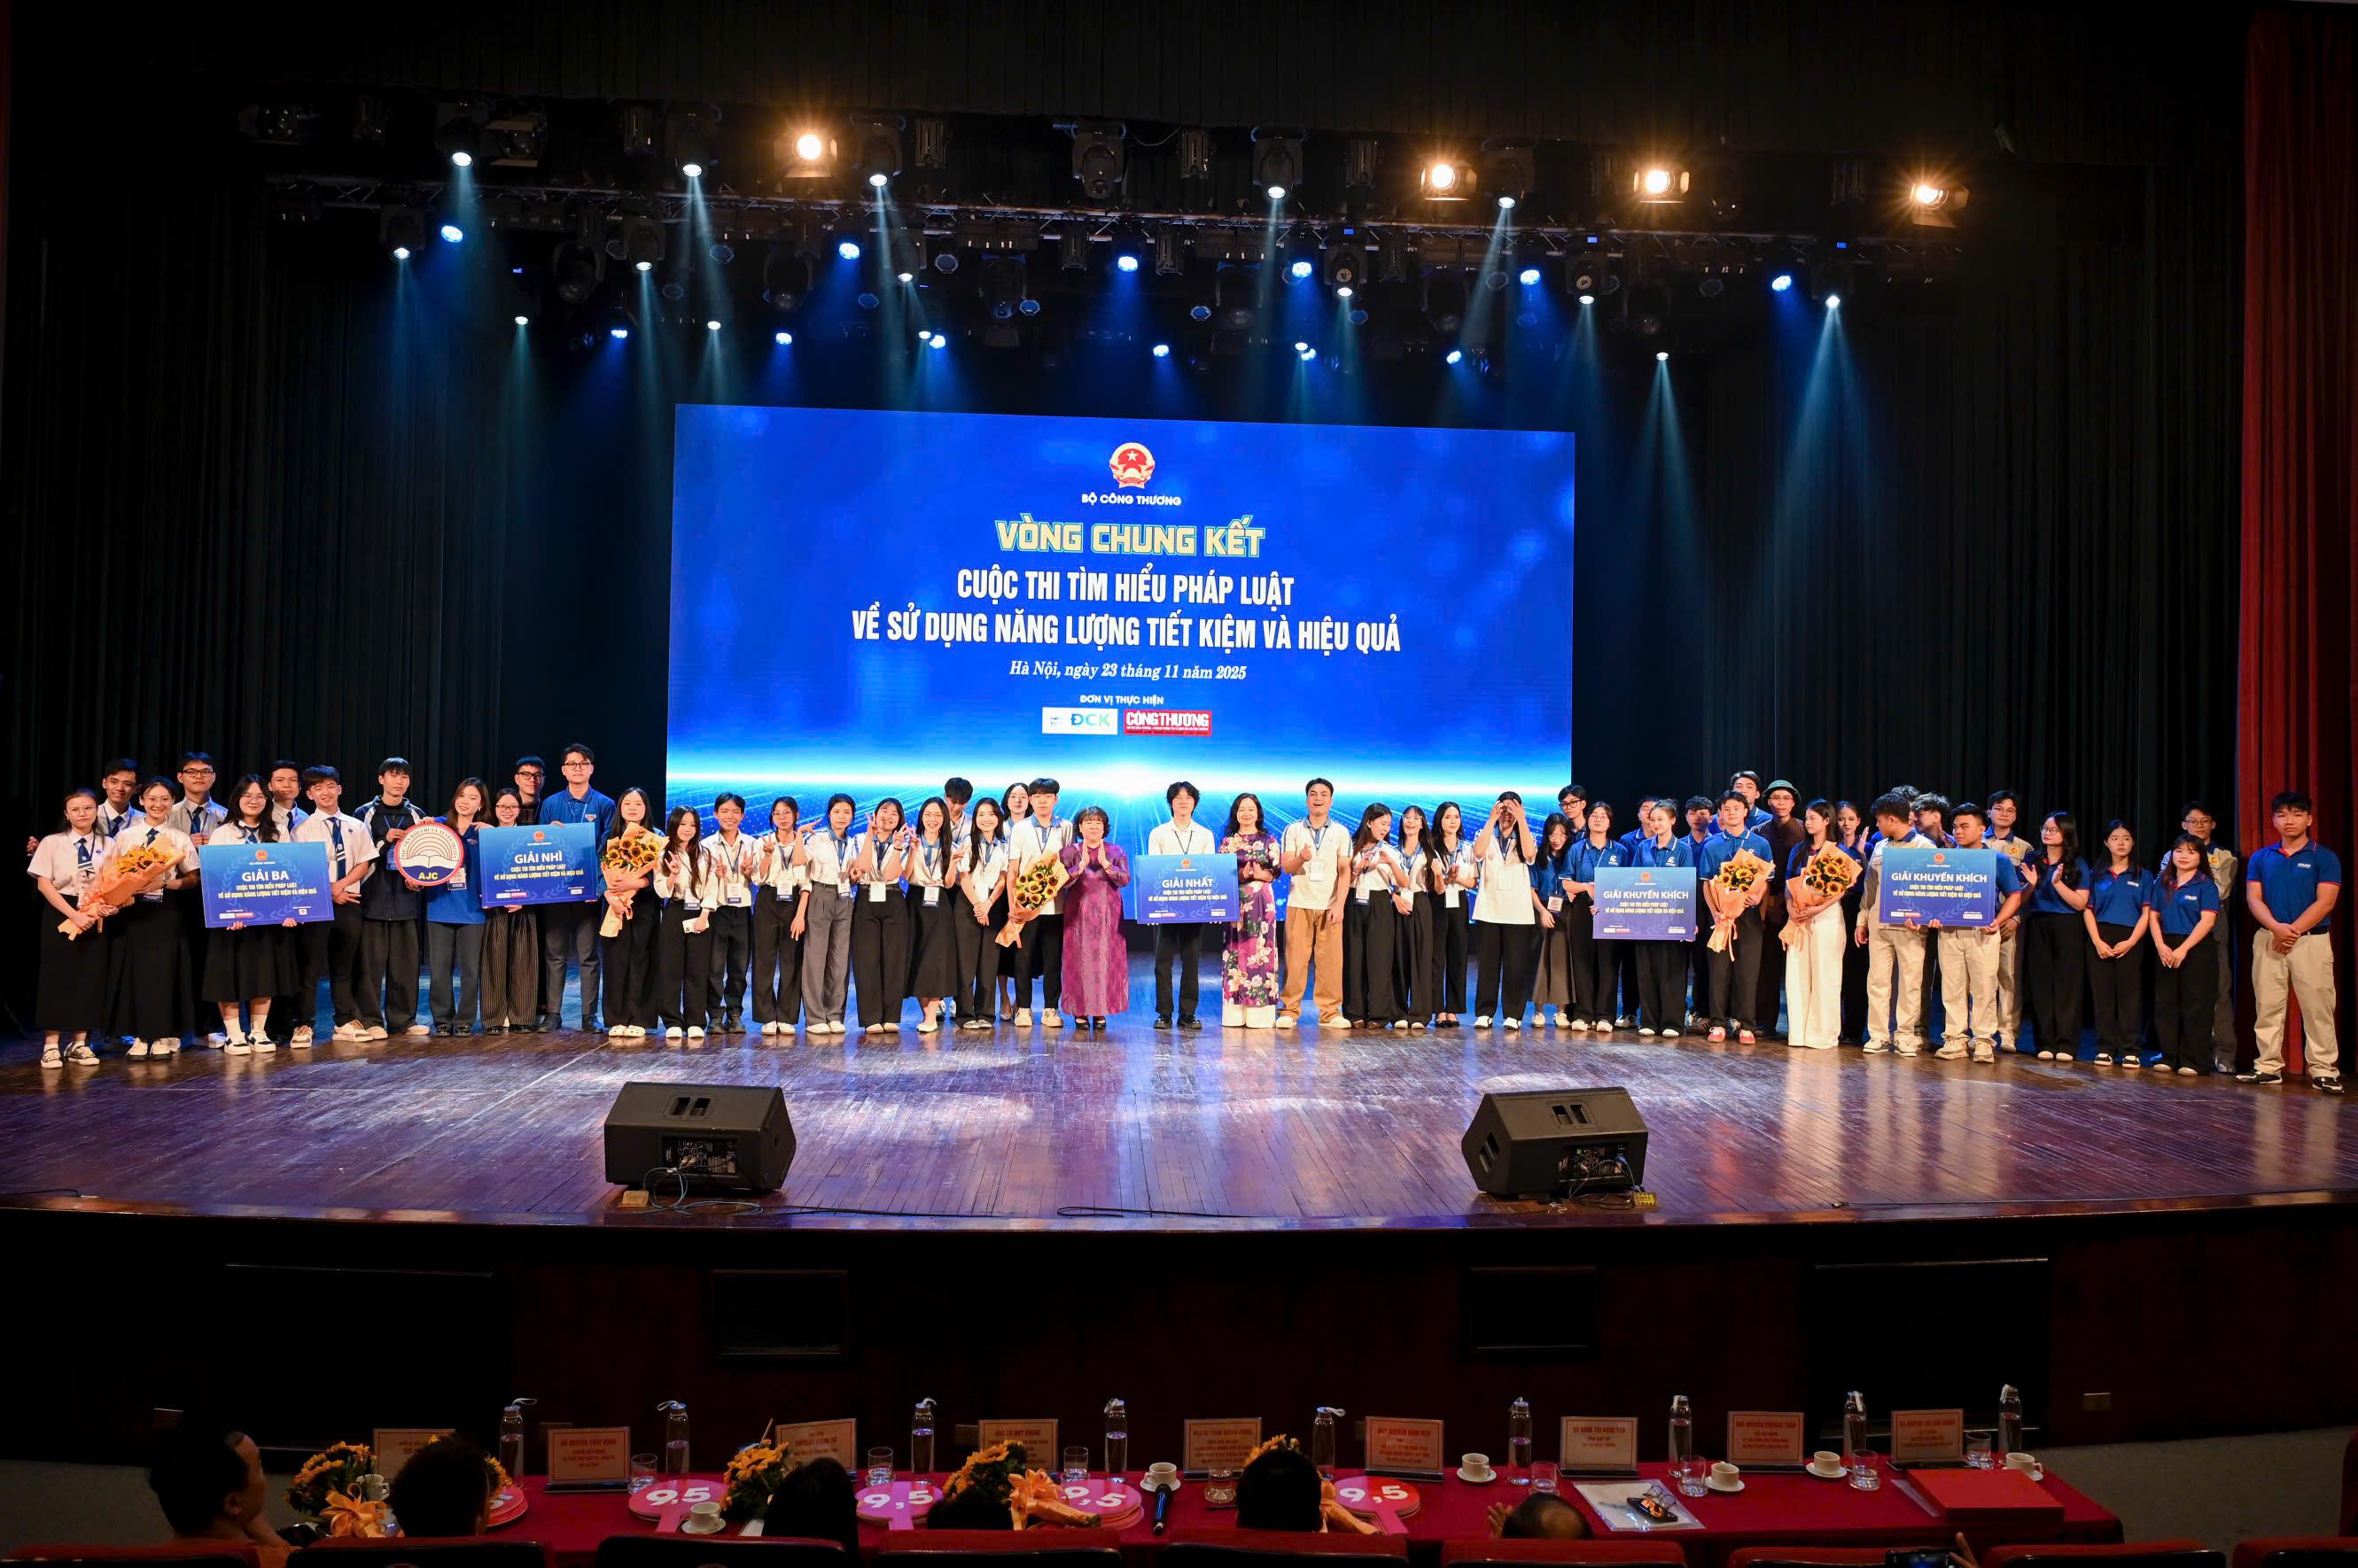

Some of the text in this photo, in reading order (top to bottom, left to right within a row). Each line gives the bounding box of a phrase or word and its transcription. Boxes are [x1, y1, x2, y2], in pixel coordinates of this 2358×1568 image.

[1081, 492, 1182, 506] BỘ CÔNG THƯƠNG
[994, 512, 1266, 558] VÒNG CHUNG KẾT
[957, 563, 1295, 611] CUỘC THI TÌM HIỂU PHÁP LUẬT
[852, 601, 1401, 656] VỀ SỬ DỤNG NĂNG LƯỢNG TIẾT KIỆM VÀ HIỆU QUẢ
[1009, 660, 1248, 680] Hà Nội, ngày 23 tháng 11 năm 2025
[1079, 694, 1164, 707] ĐƠN VỊ THỰC HIỆN
[514, 850, 564, 864] GIẢI NHÌ
[242, 869, 290, 881] GIẢI BA
[1162, 875, 1214, 889] GIẢI NHẤT
[1891, 871, 1988, 883] GIẢI KHUYẾN KHÍCH
[1603, 889, 1689, 899] GIẢI KHUYẾN KHÍCH
[645, 1486, 712, 1505] 9,5
[863, 1490, 934, 1509] 9,5
[1064, 1486, 1127, 1508] 9,5
[1339, 1485, 1409, 1503] 9,5
